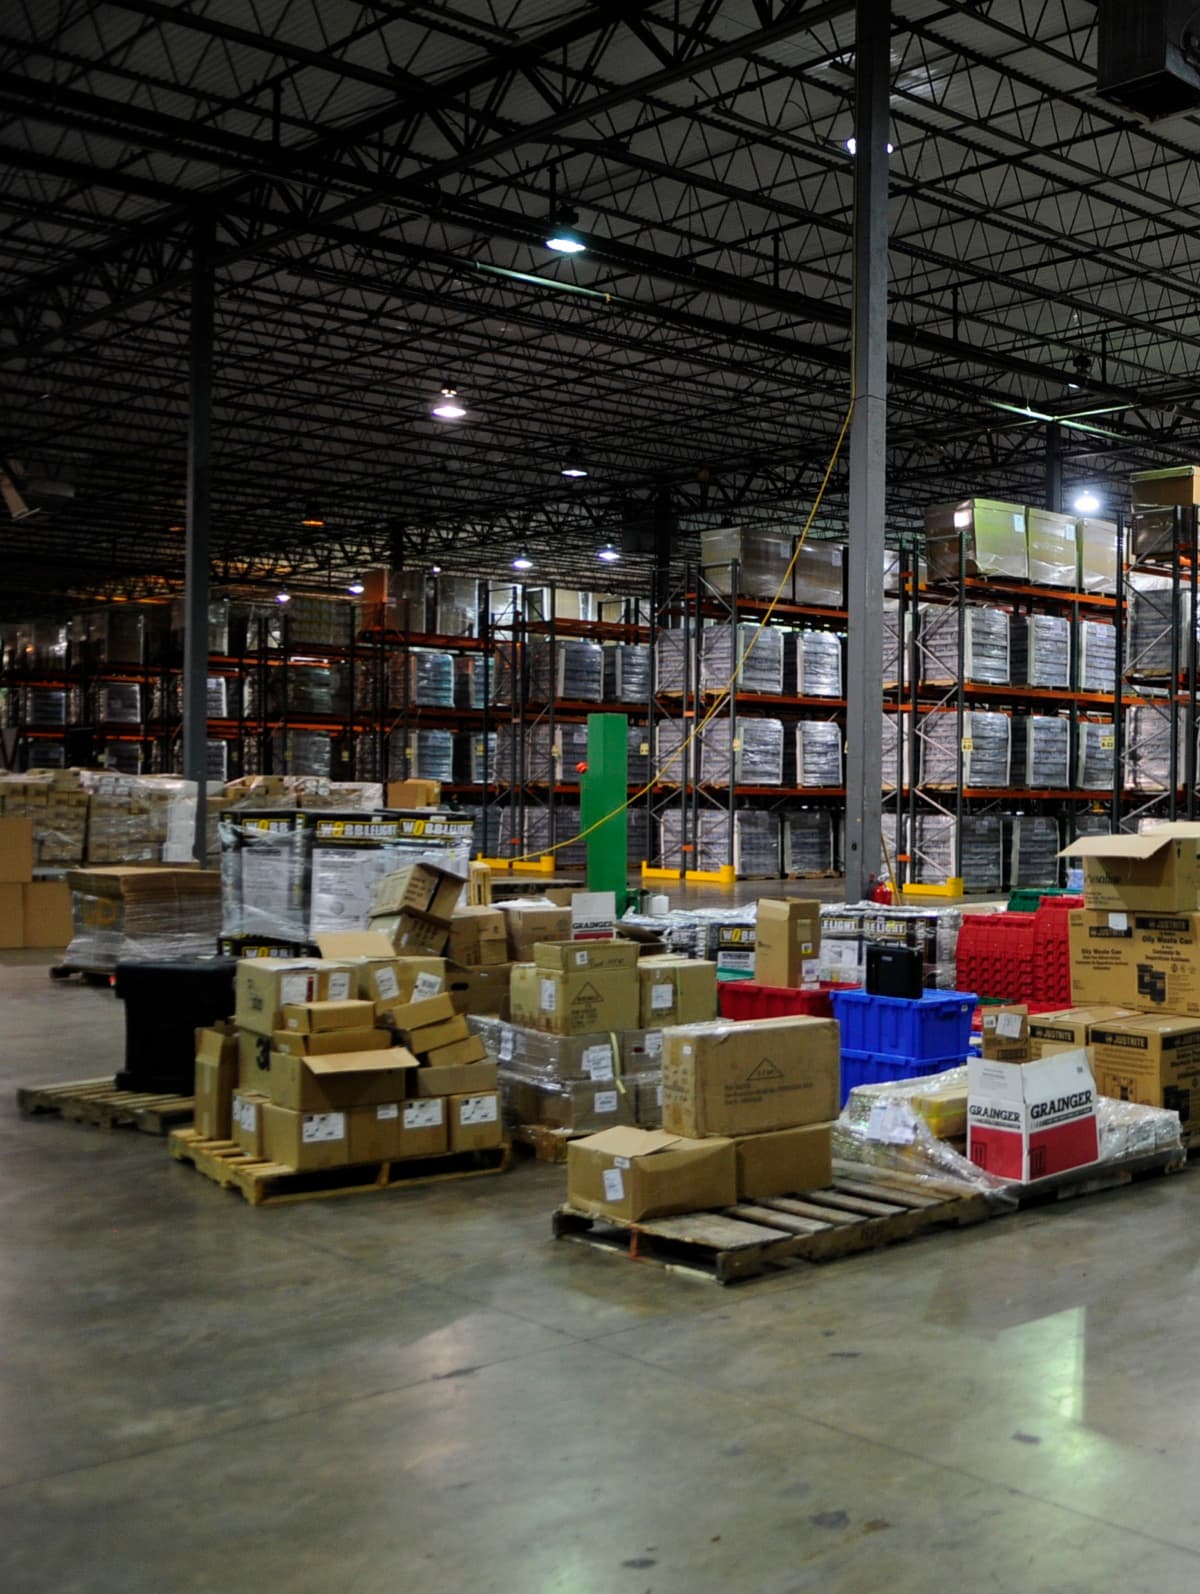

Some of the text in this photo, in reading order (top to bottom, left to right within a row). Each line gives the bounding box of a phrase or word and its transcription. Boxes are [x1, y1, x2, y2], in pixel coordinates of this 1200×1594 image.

[573, 921, 613, 929] GRAINGER
[1113, 1033, 1145, 1048] JUSTRITE
[1030, 1090, 1092, 1119] GRAINGER
[969, 1105, 1020, 1121] GRAINGER
